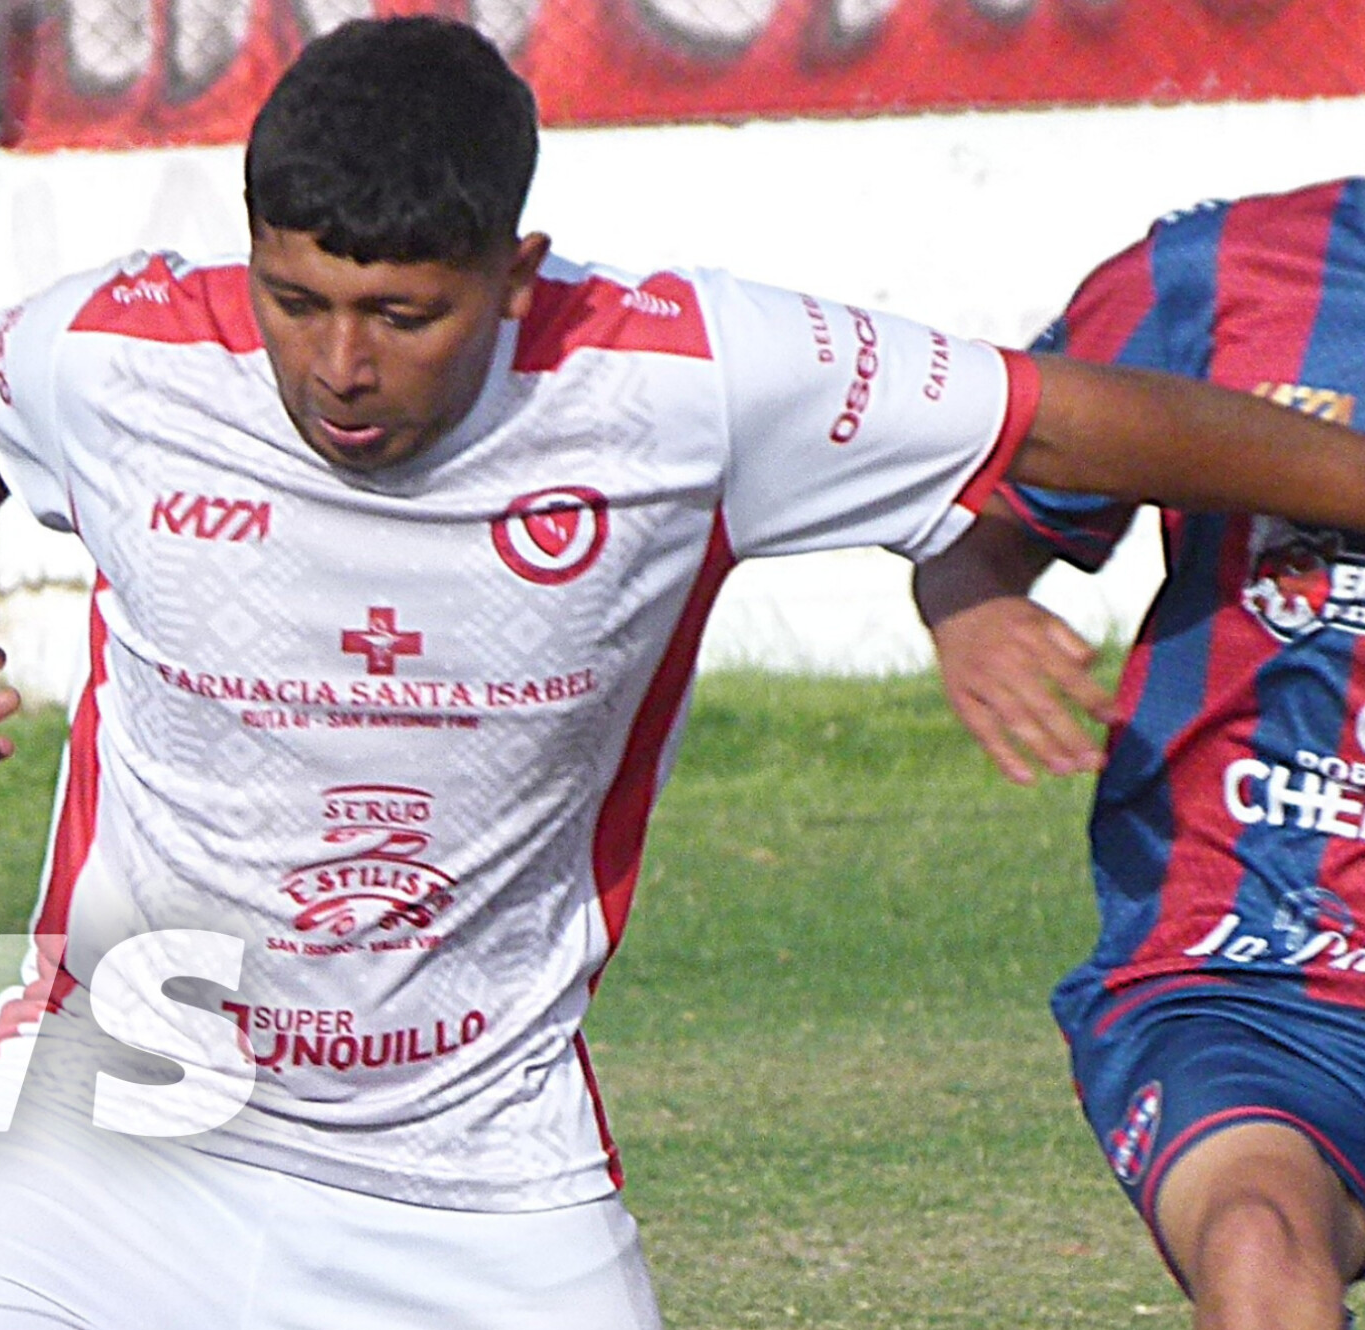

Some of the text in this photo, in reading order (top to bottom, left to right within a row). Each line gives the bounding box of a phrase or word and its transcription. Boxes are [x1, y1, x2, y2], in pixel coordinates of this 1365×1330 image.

[155, 663, 599, 708] FARMACIA SANTA ISABEL
[1222, 758, 1365, 840] CHE
[253, 1005, 354, 1035] SUPER
